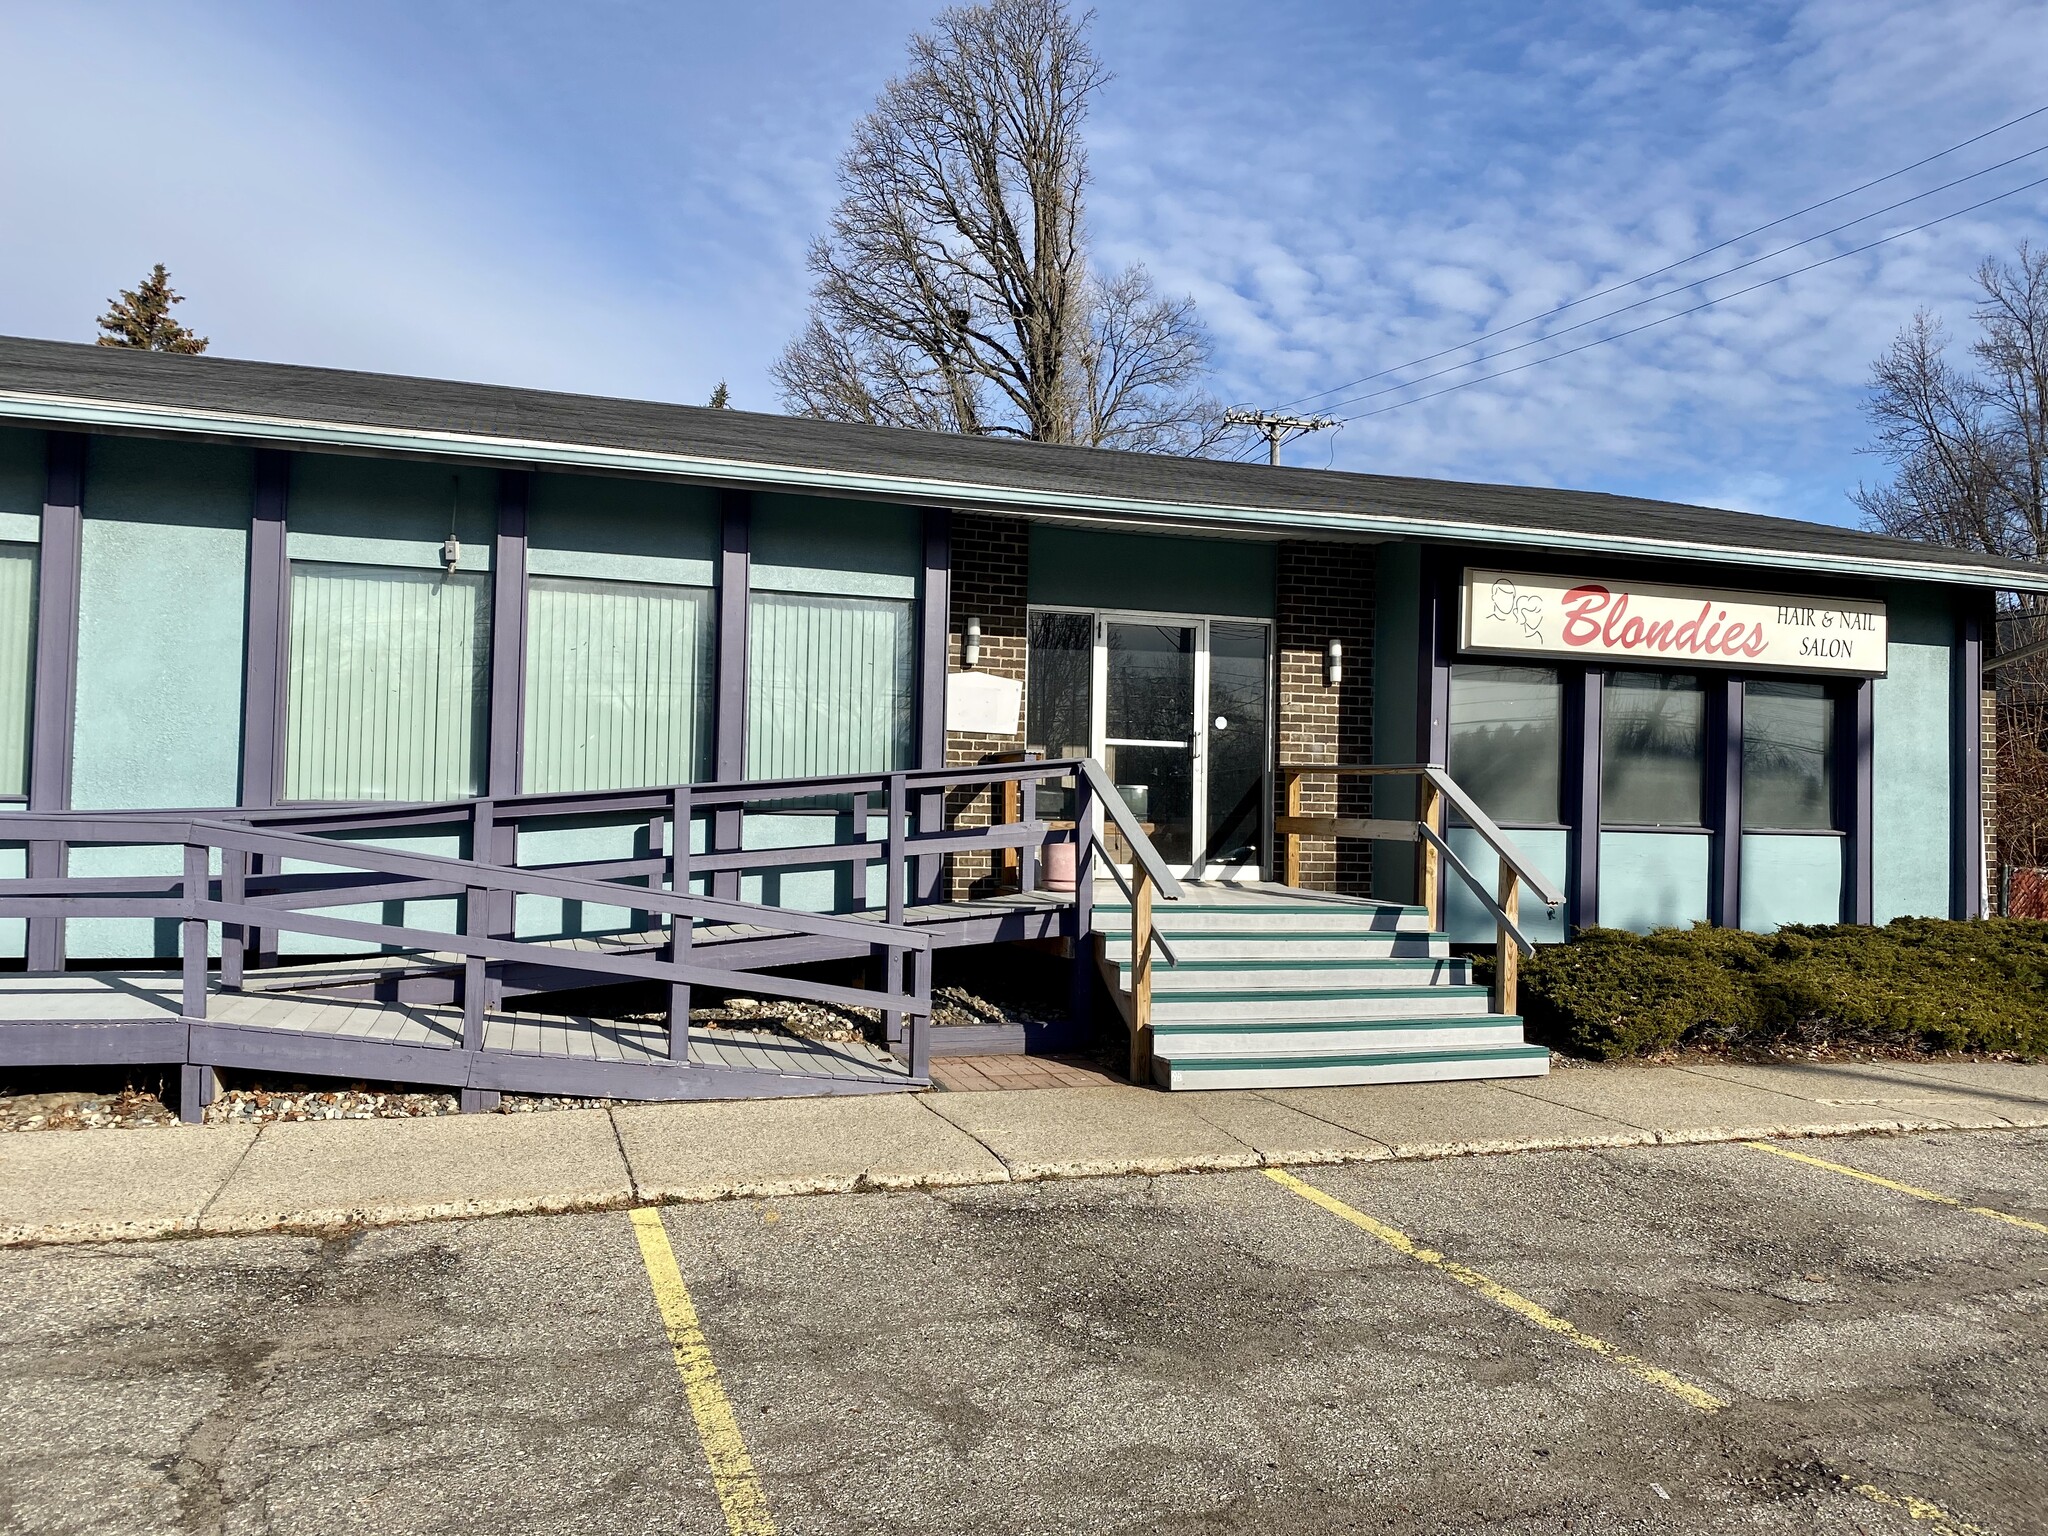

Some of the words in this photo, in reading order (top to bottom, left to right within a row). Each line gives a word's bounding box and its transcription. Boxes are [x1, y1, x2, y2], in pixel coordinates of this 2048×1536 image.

[1561, 585, 1769, 658] Blondies
[1777, 605, 1815, 627] HAIR
[1821, 611, 1833, 628] &
[1839, 611, 1876, 632] NAIL
[1799, 636, 1853, 659] SALON
